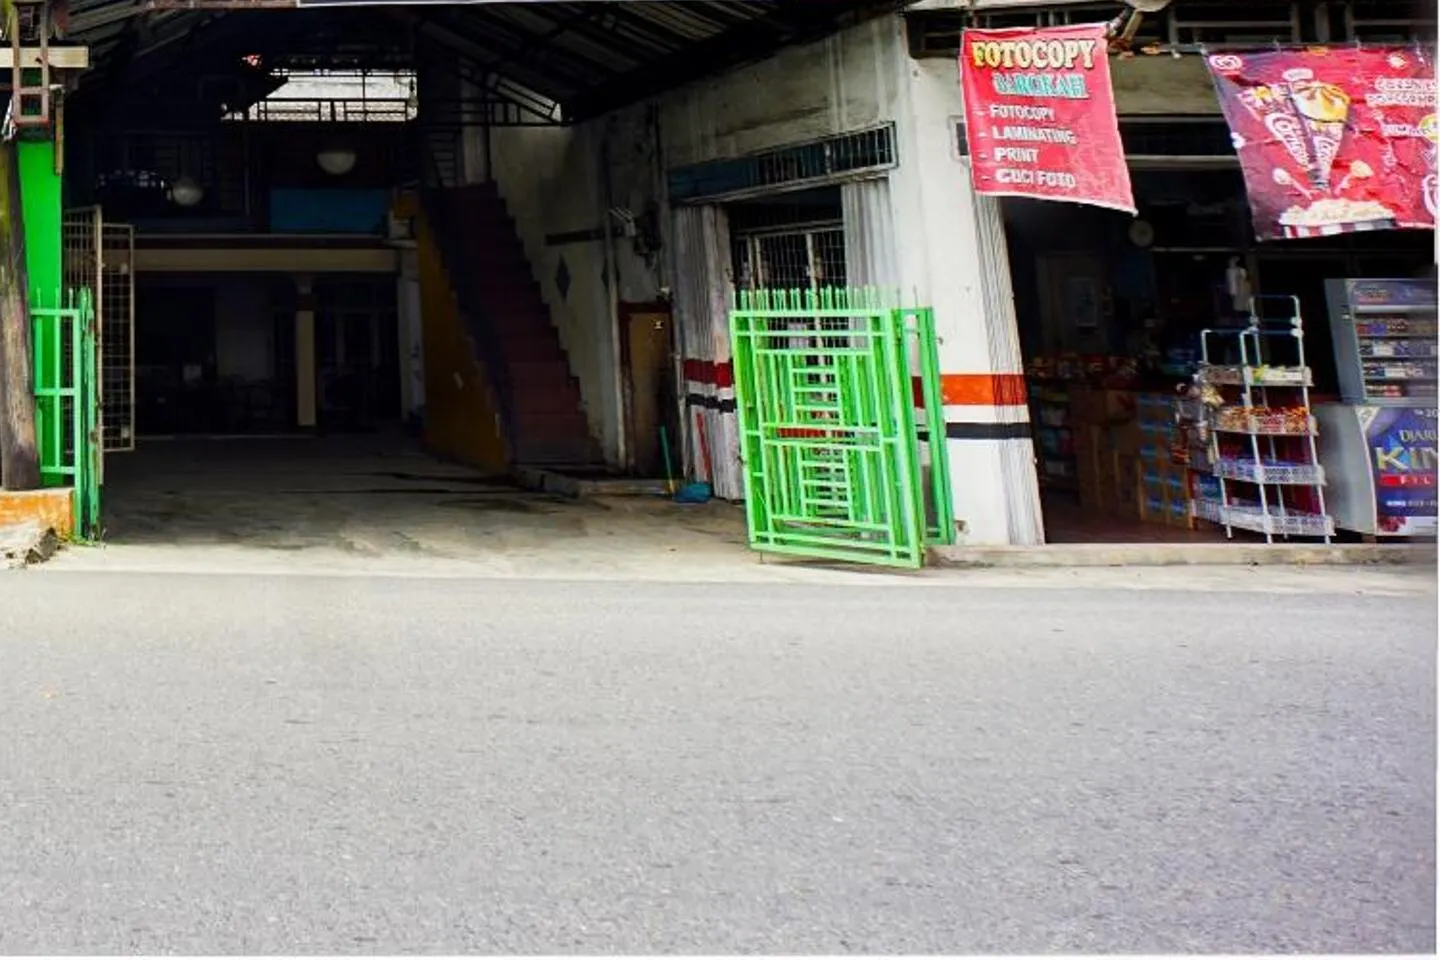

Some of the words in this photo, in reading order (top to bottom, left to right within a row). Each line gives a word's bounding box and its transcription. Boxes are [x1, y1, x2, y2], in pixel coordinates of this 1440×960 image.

[971, 39, 1096, 69] FOTOCOPY
[992, 126, 1077, 145] LAMINATING
[994, 147, 1040, 163] PRINT
[1037, 170, 1077, 189] FOTO
